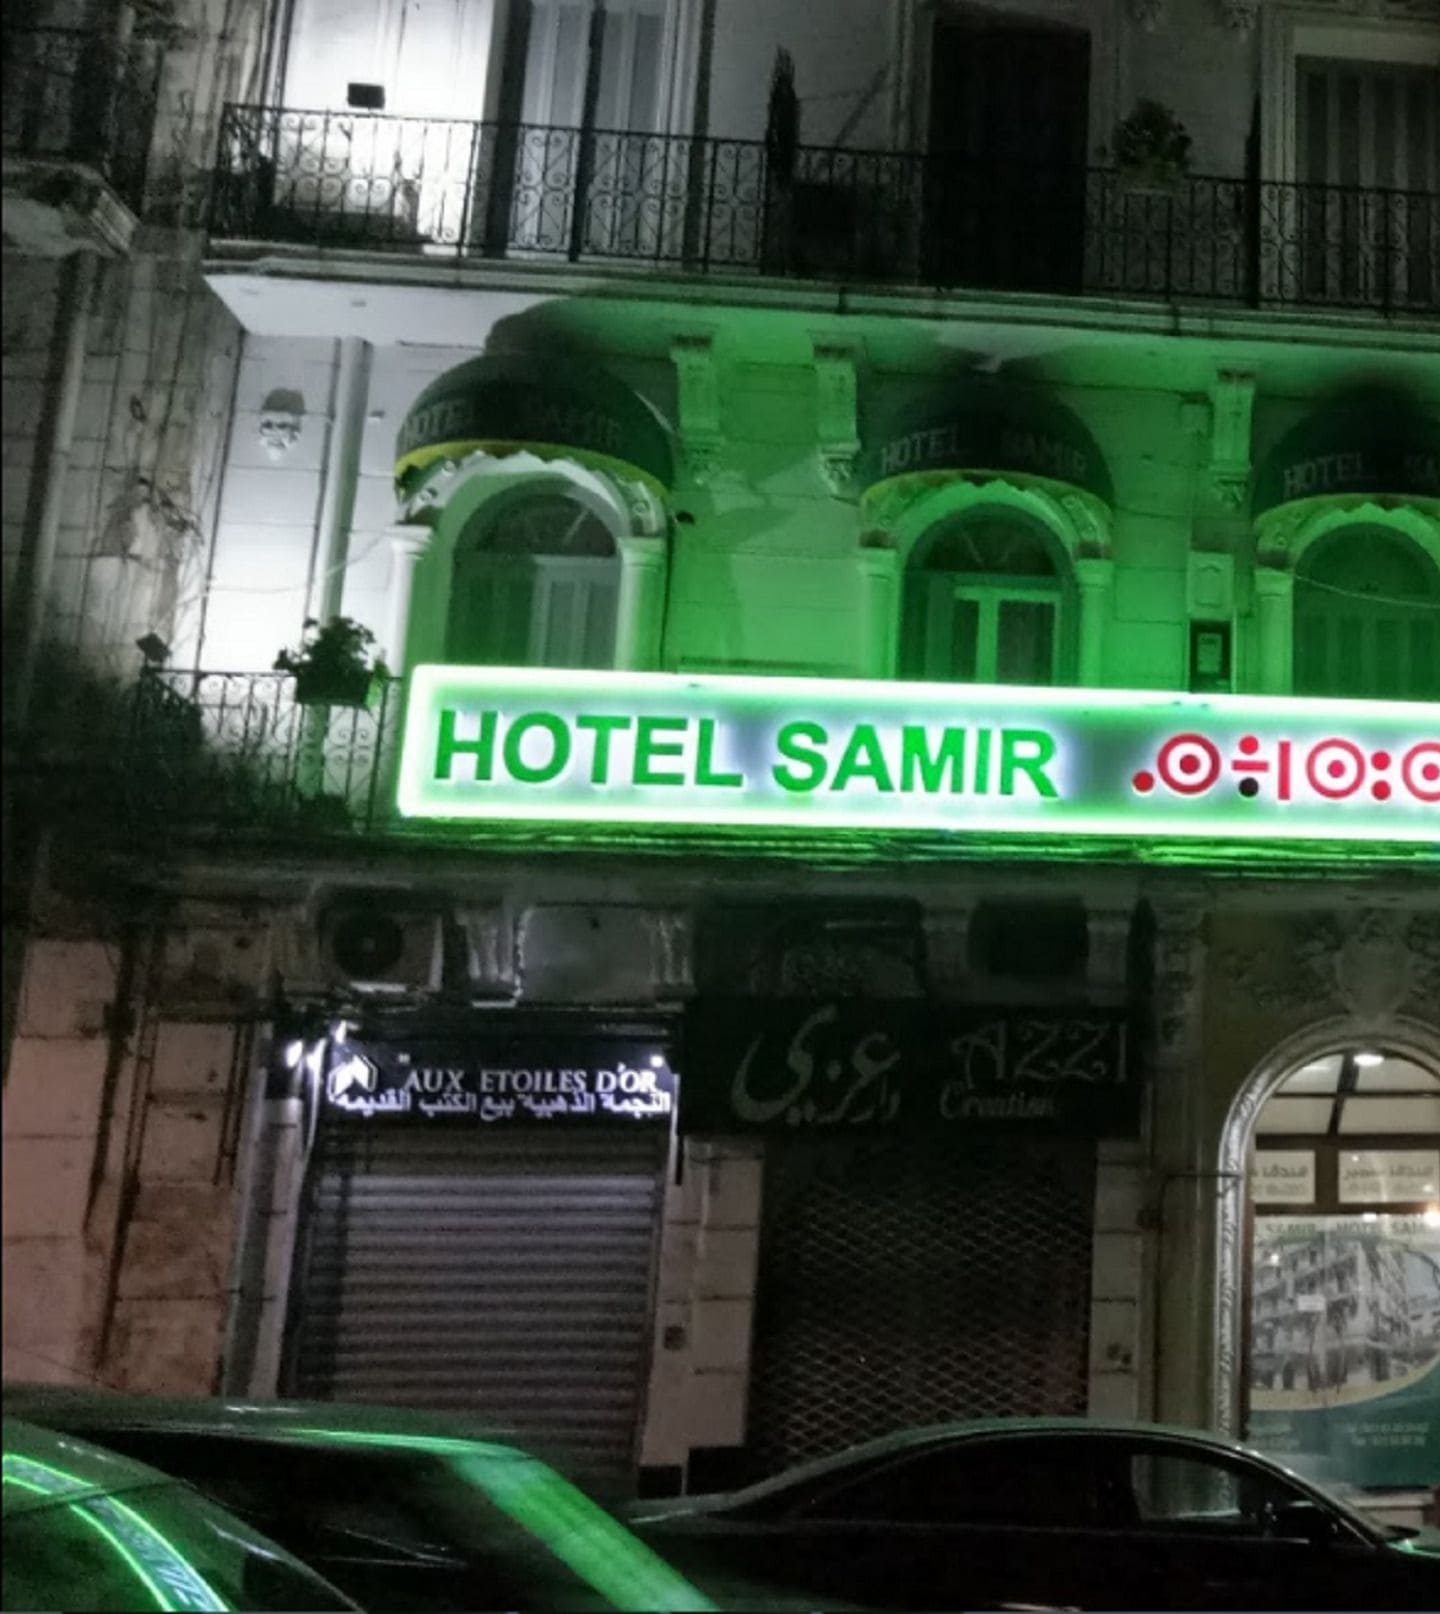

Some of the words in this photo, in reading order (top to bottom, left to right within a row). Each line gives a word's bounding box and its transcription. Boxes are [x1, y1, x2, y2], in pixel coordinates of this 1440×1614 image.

[881, 421, 970, 476] HOTEL
[433, 708, 744, 788] HOTEL
[771, 721, 1060, 799] SAMIR
[951, 1019, 1127, 1089] AZZI
[404, 1069, 465, 1092] AUX
[480, 1069, 587, 1093] ETOILES
[595, 1062, 660, 1093] D'OR
[418, 1091, 478, 1118] الكتب
[480, 1095, 516, 1121] بيع
